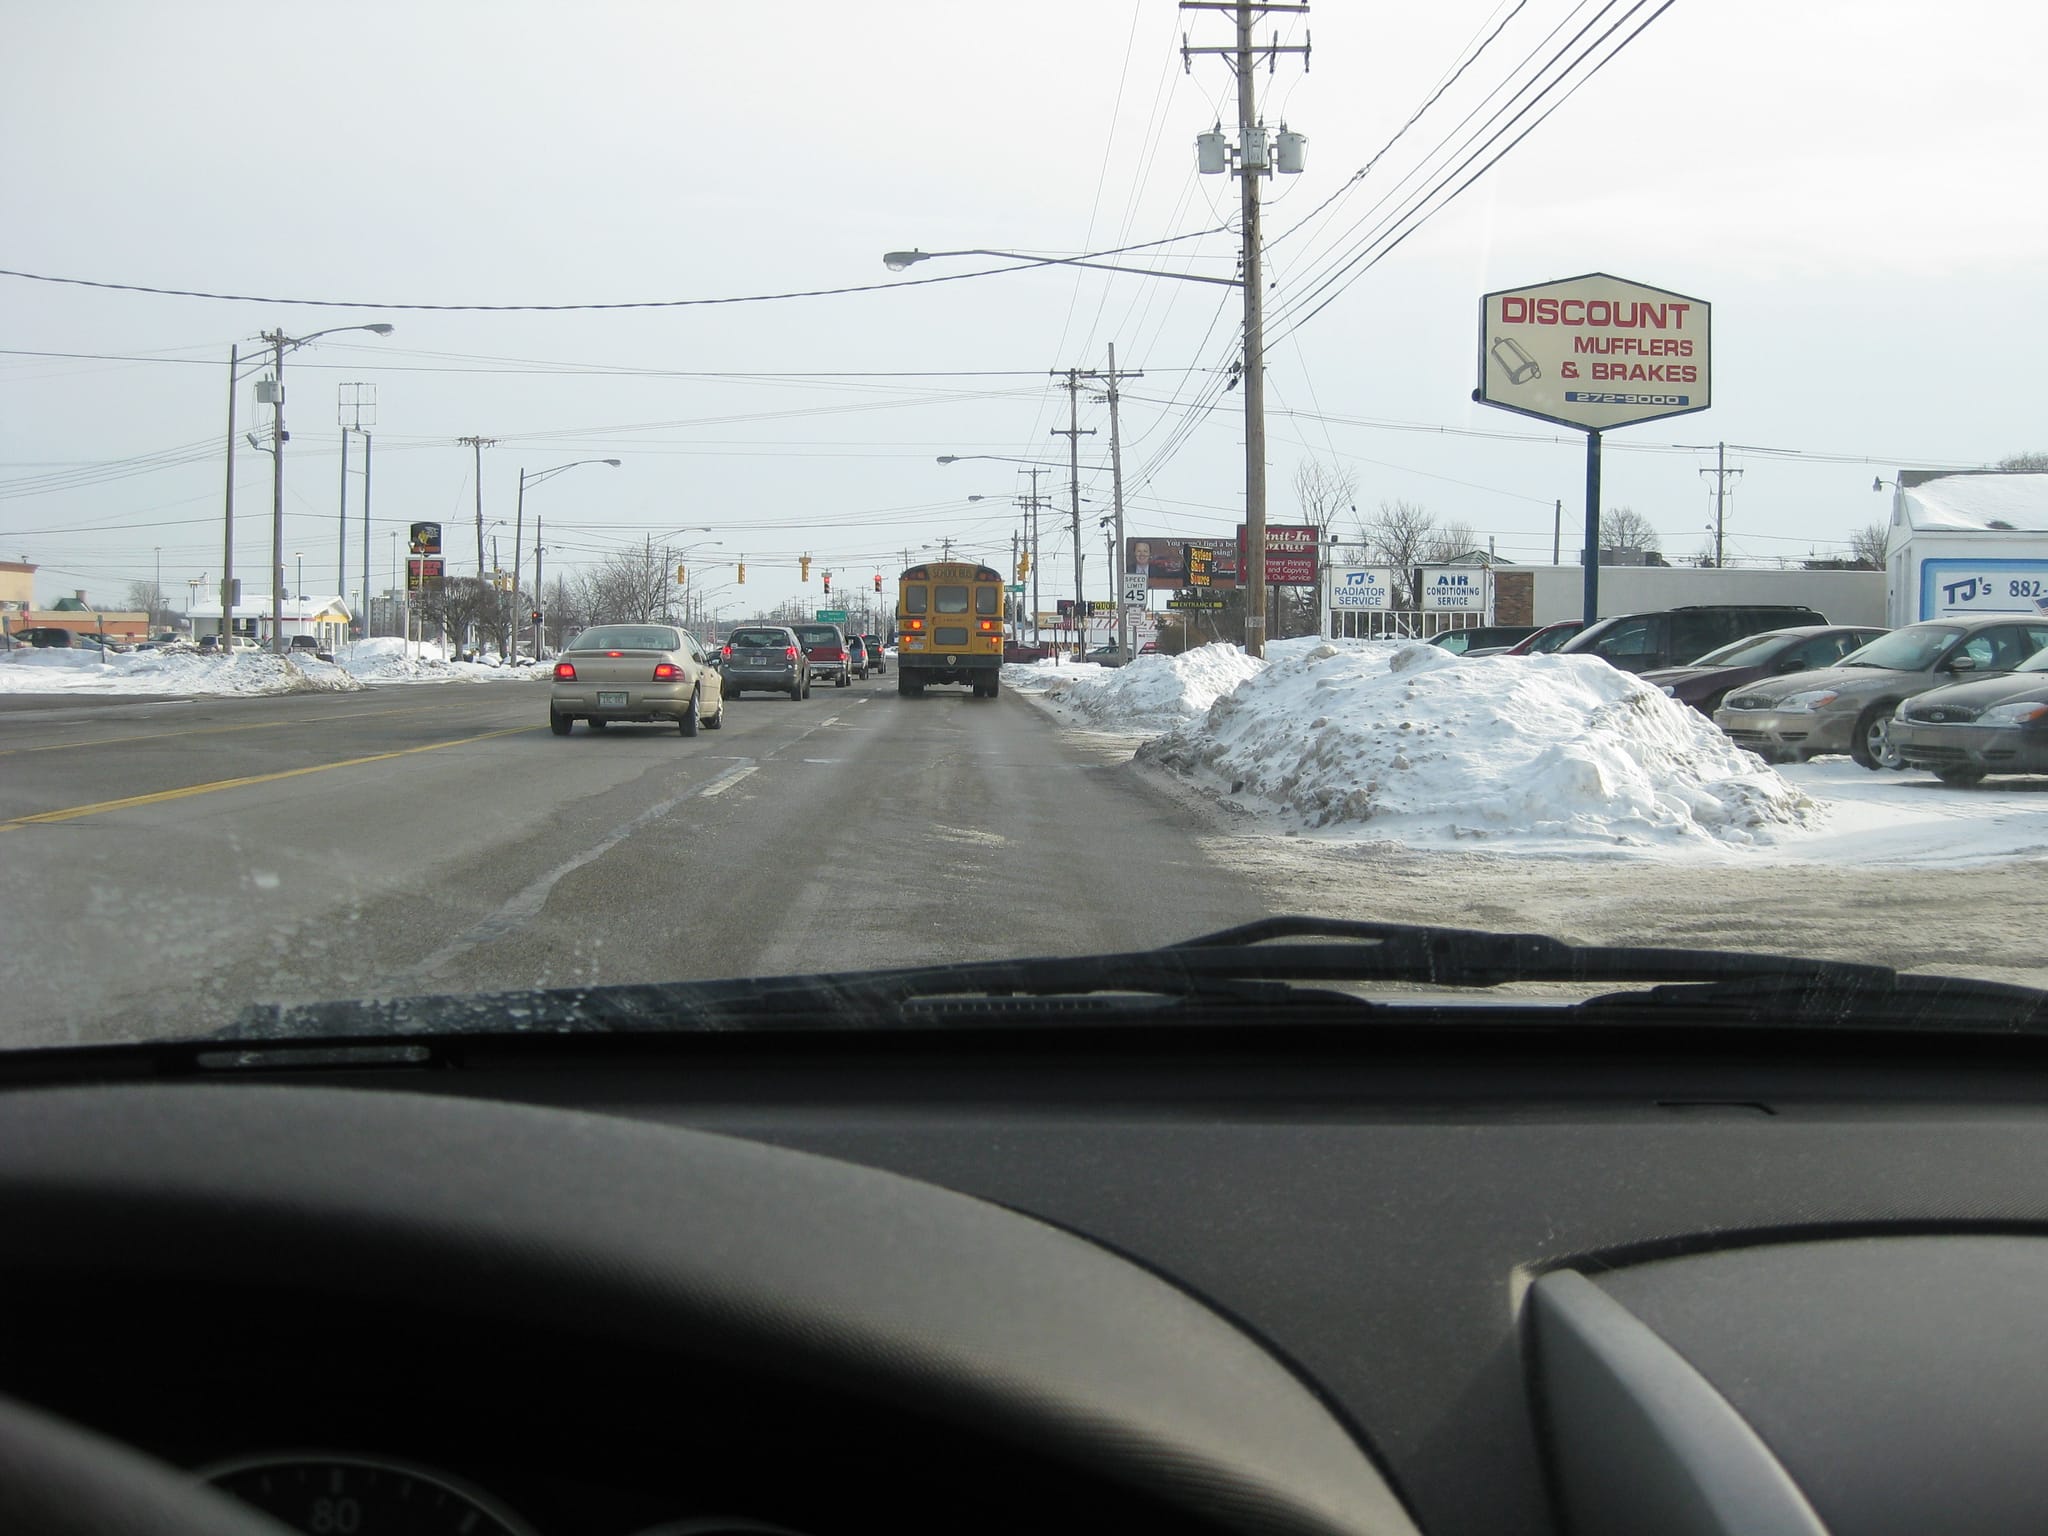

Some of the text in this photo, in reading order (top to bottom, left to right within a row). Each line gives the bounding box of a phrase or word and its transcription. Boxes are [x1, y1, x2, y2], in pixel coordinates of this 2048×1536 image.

[1502, 297, 1690, 329] DISCOUNT
[1574, 336, 1693, 357] MUFFLERS
[1561, 362, 1697, 383] & BRAKES
[1576, 393, 1680, 405] 272-9000
[1190, 547, 1212, 562] Payless
[1190, 560, 1206, 573] Shoe
[1190, 573, 1211, 586] Source
[1345, 571, 1375, 585] TJ's
[1437, 575, 1469, 586] AIR
[1125, 589, 1145, 602] 45
[1334, 587, 1385, 597] RADIATOR
[1426, 586, 1480, 596] CONDITIONING
[1942, 576, 1992, 605] TJ's
[1338, 596, 1381, 606] SERVICE
[1437, 597, 1468, 606] SERVICE
[309, 1497, 362, 1535] 80
